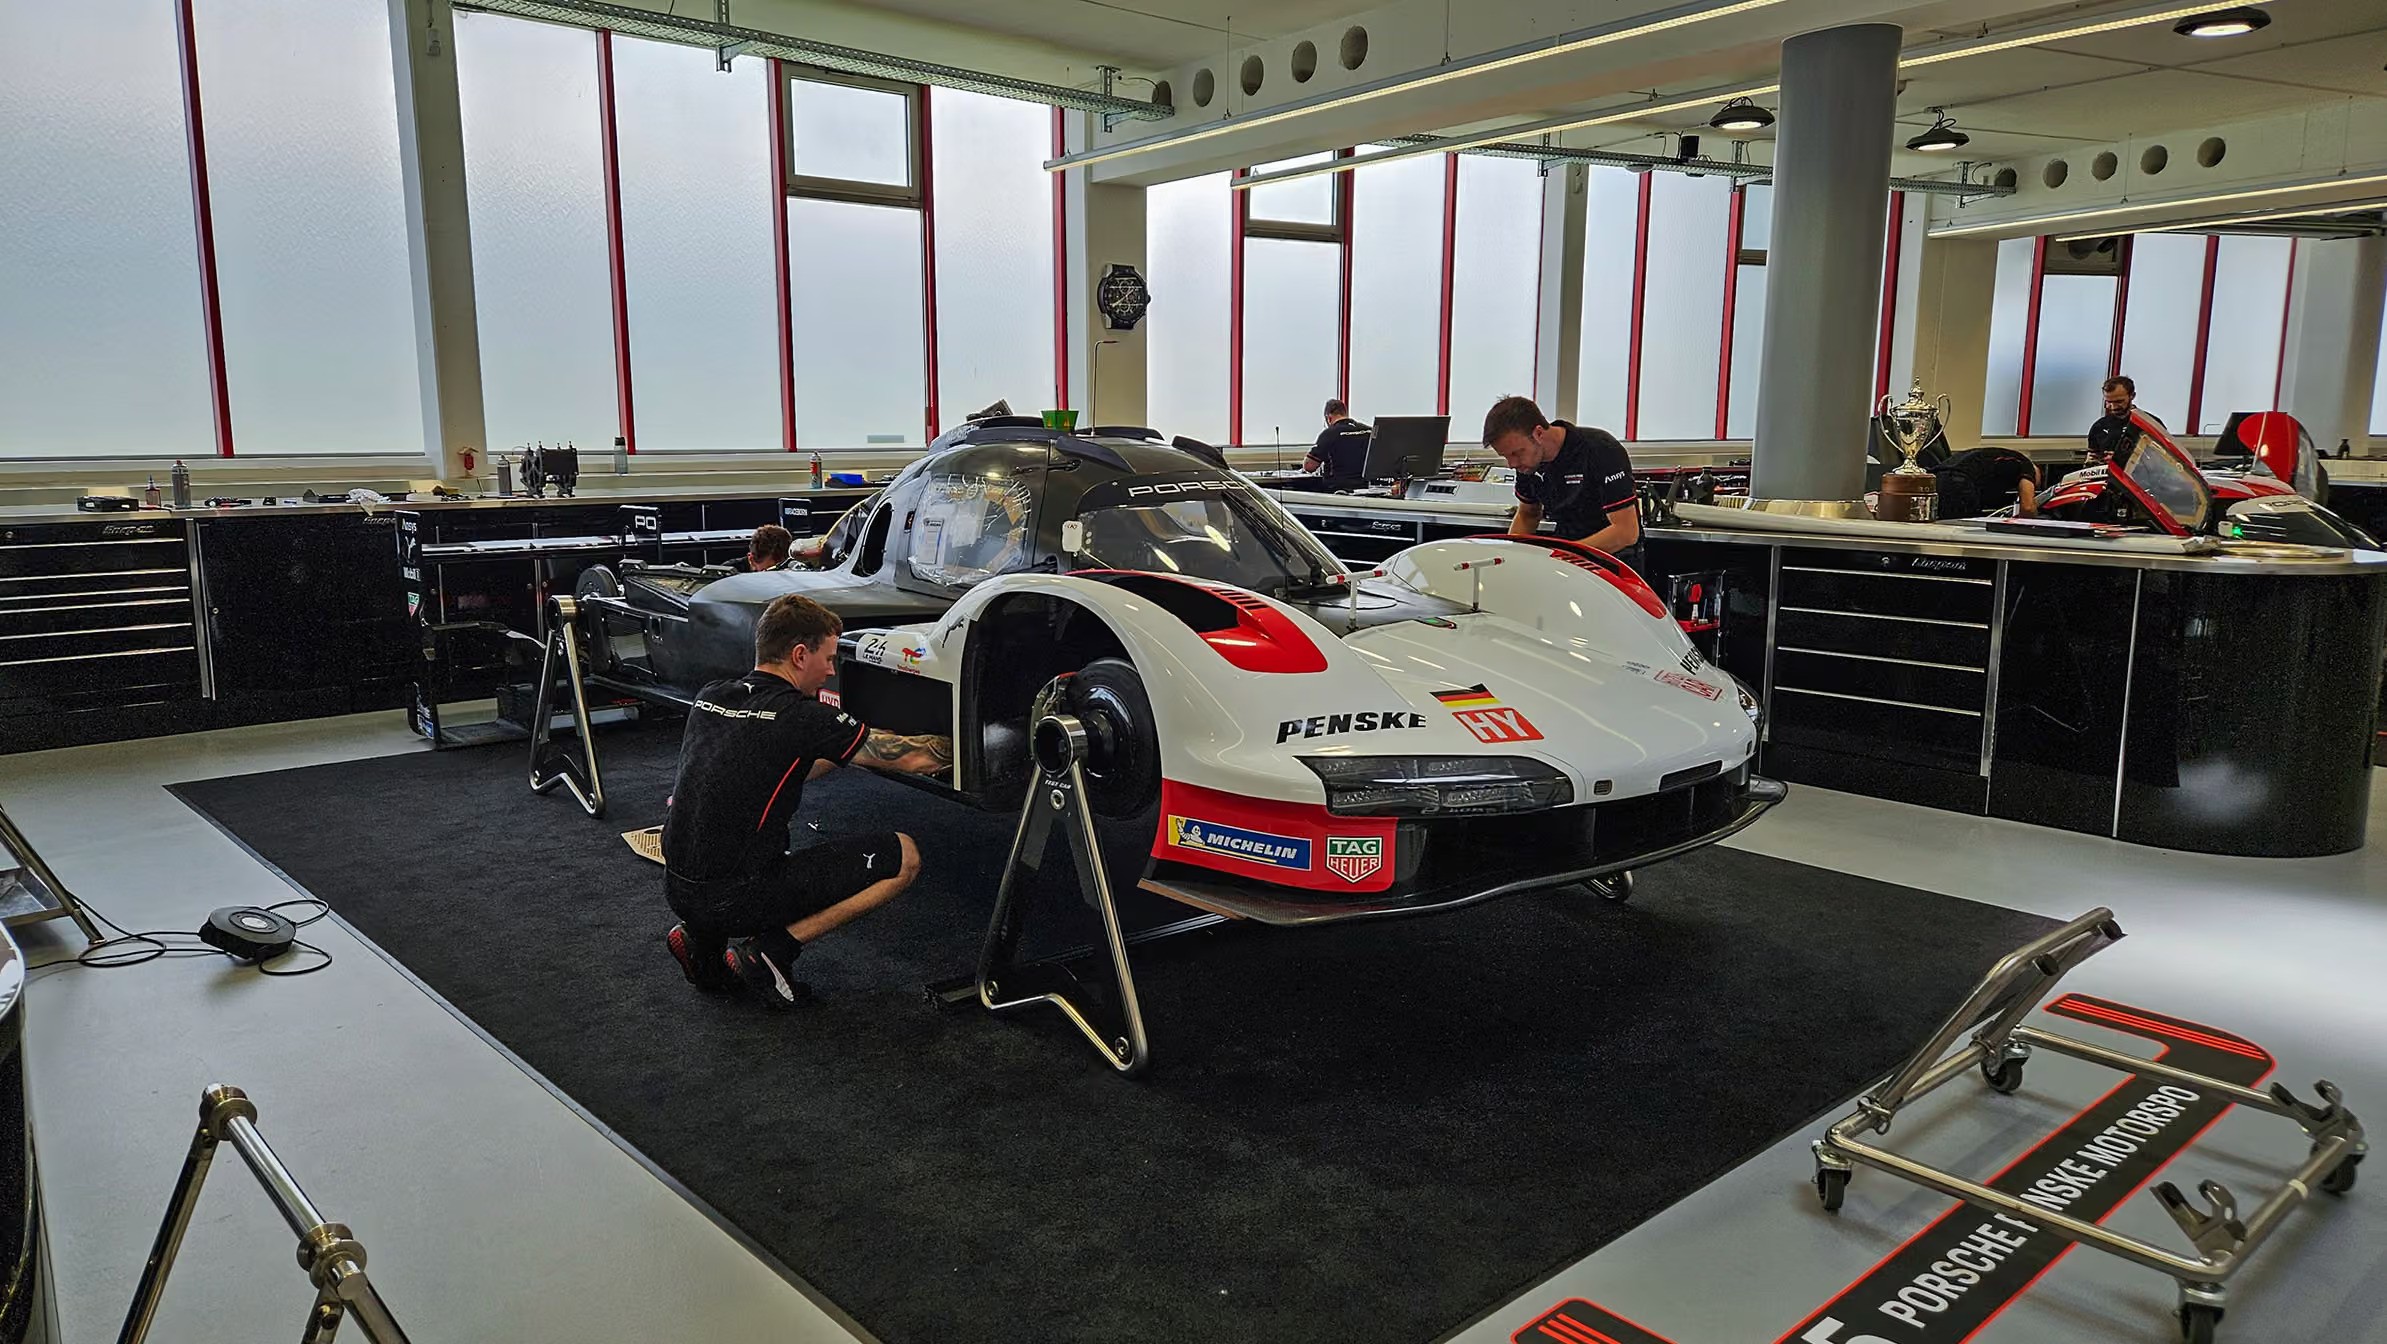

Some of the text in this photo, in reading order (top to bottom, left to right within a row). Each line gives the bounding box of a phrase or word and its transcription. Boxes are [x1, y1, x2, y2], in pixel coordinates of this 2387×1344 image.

[1604, 470, 1626, 484] Ansys
[1128, 480, 1247, 498] PORSC
[694, 699, 777, 721] PORSCHE
[1276, 711, 1427, 745] PENSKE
[1458, 710, 1528, 741] HY
[1207, 832, 1297, 860] MICHELIN
[1331, 840, 1377, 855] TAG
[1330, 857, 1378, 878] HEUER
[1878, 1223, 2028, 1329] PORSCHE
